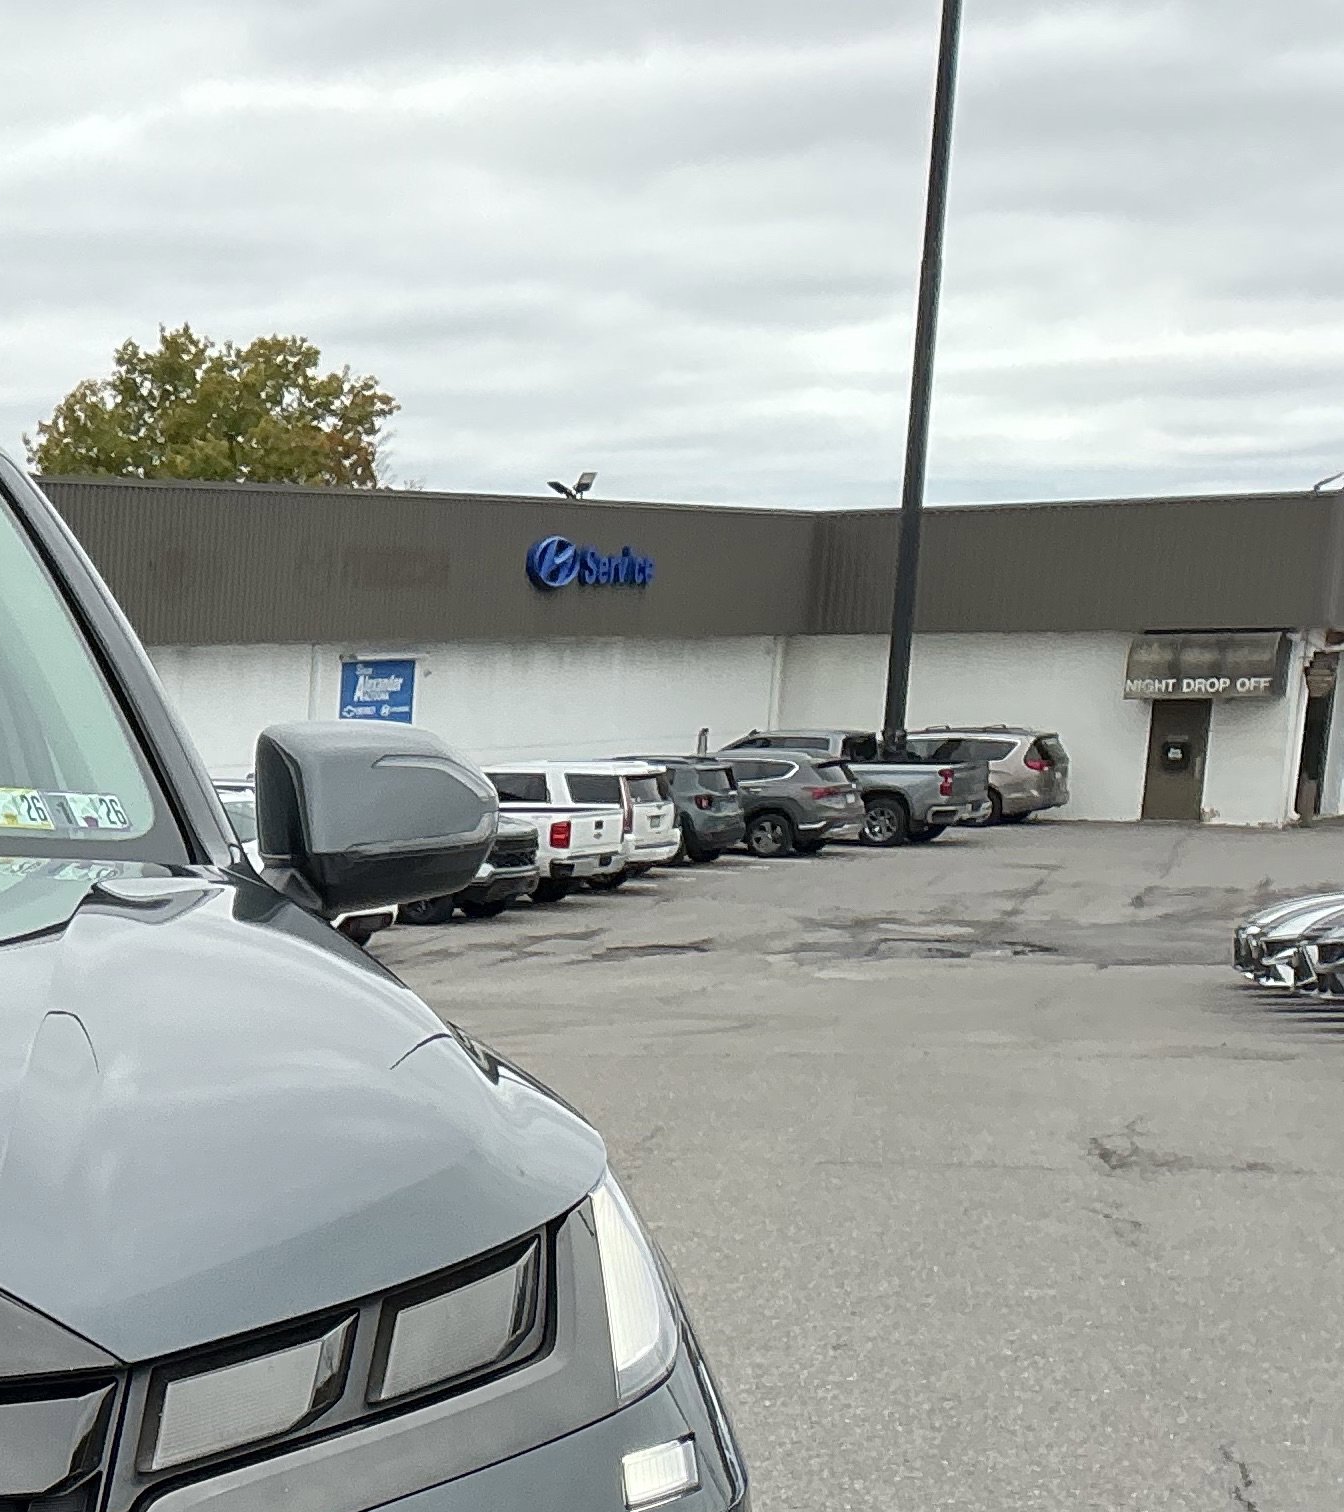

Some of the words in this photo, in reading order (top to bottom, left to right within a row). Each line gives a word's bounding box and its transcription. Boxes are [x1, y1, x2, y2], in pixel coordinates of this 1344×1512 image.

[579, 545, 655, 585] Service
[1125, 678, 1177, 693] NIGHT
[1182, 678, 1231, 693] DROP
[1236, 677, 1273, 693] OFF
[19, 794, 48, 822] 26
[98, 798, 128, 825] 26
